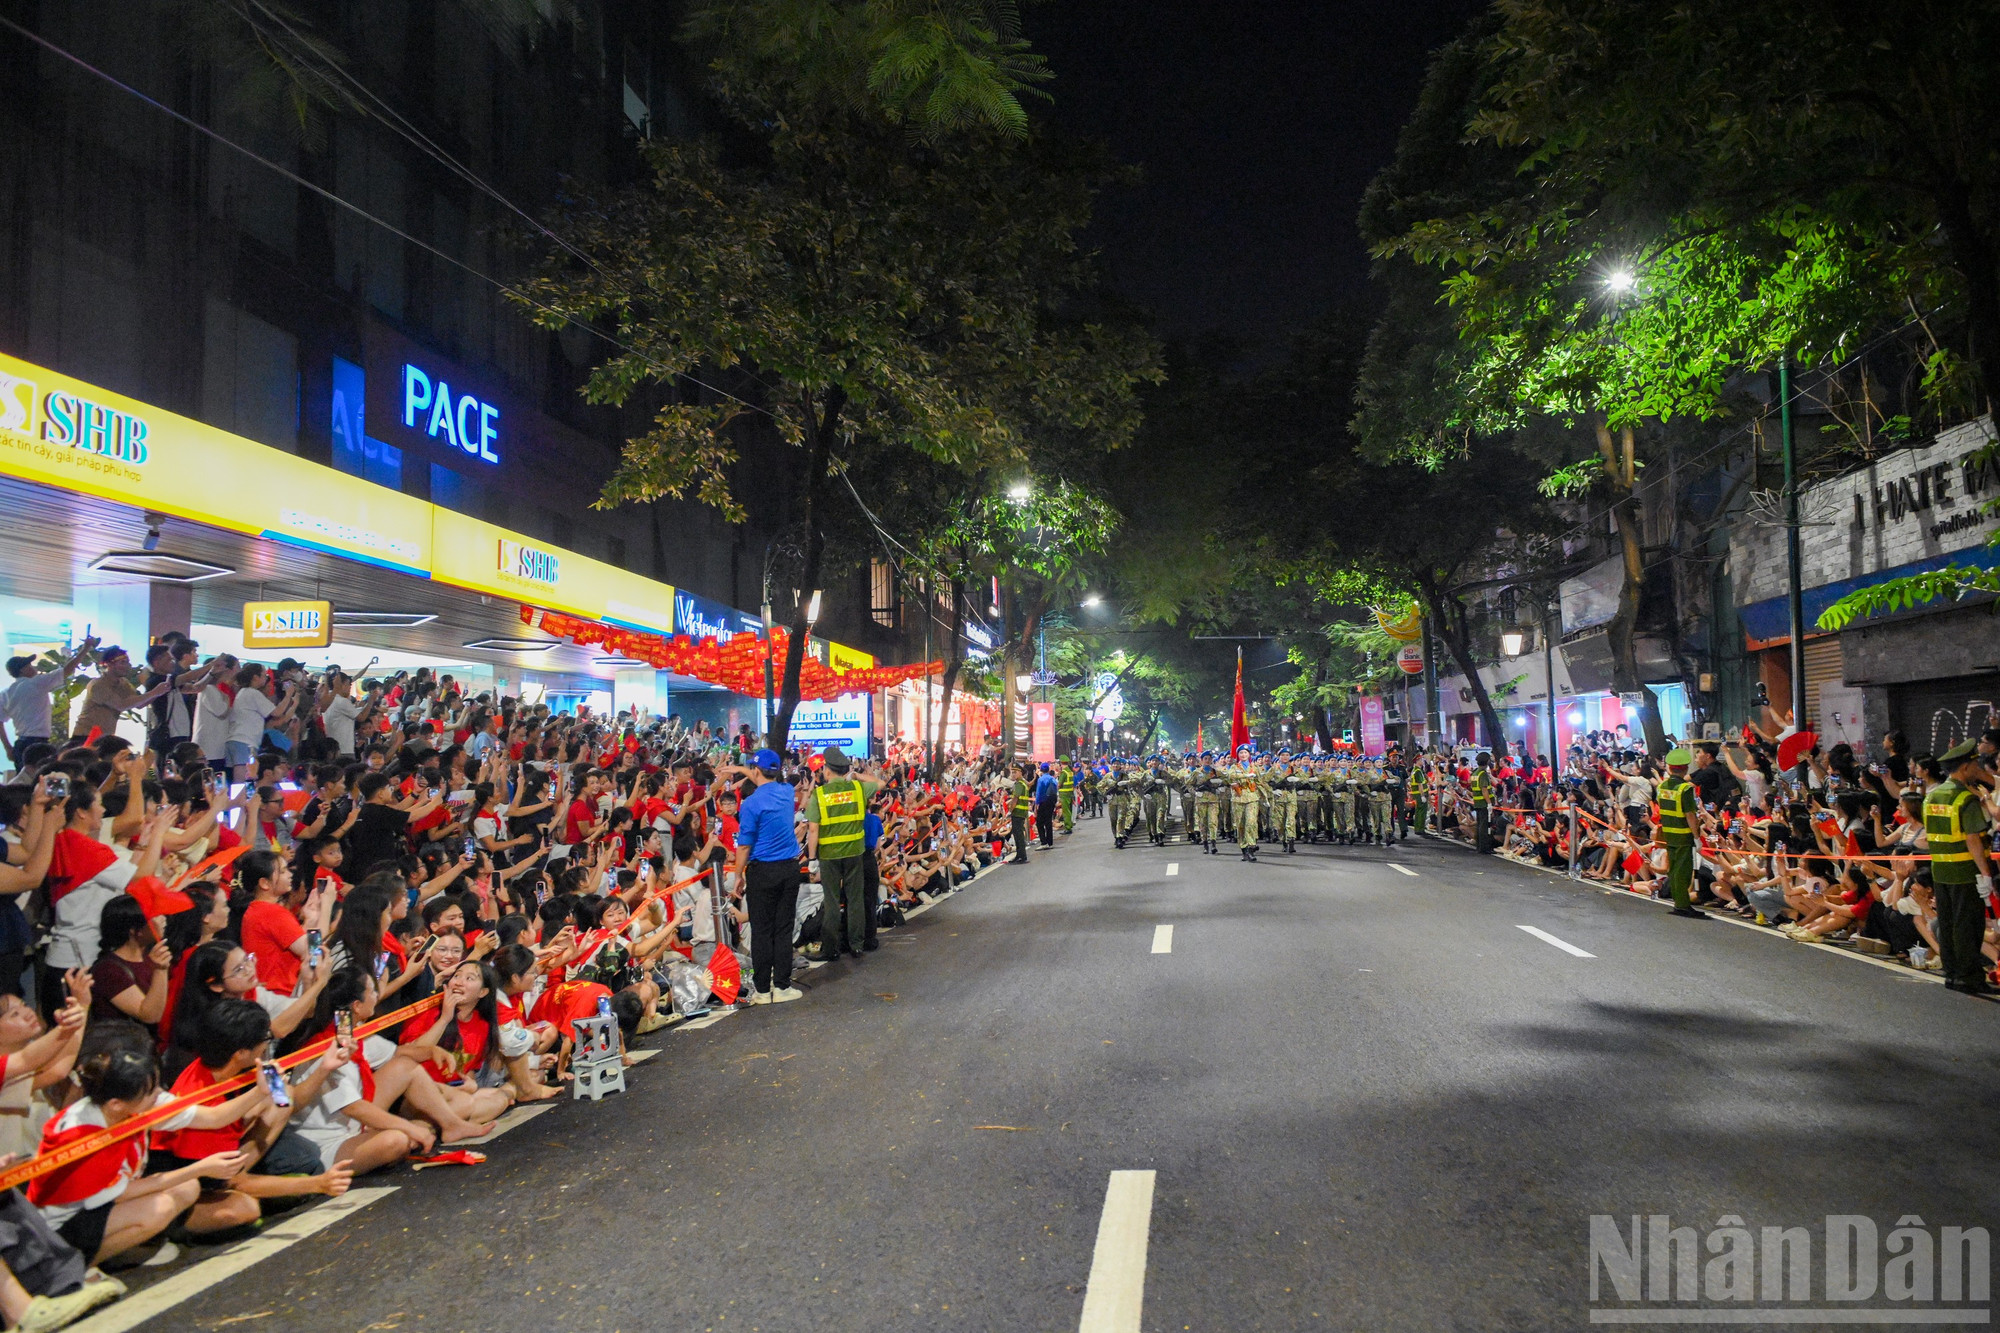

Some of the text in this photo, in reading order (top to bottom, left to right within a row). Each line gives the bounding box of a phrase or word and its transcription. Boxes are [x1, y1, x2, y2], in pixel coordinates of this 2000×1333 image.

[41, 389, 151, 465] SHB
[404, 362, 499, 465] PACE
[17, 439, 31, 452] tin
[1872, 461, 1954, 526] HATE
[517, 545, 560, 586] SHB
[275, 610, 321, 632] SHB
[69, 1143, 85, 1156] NOT
